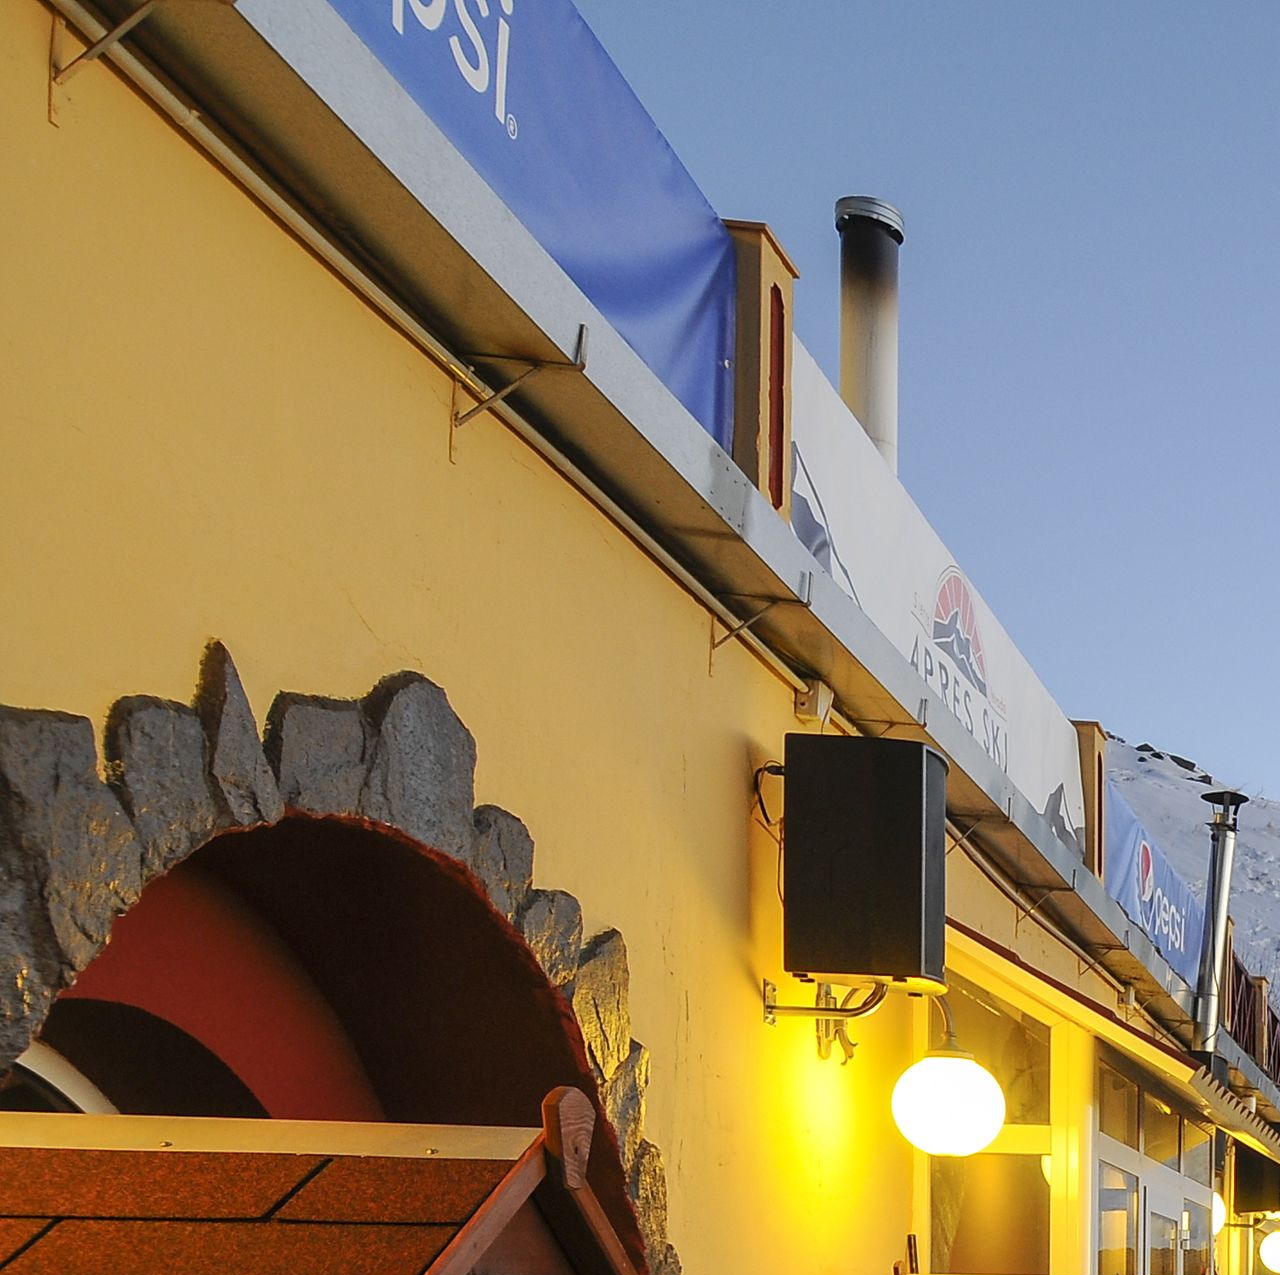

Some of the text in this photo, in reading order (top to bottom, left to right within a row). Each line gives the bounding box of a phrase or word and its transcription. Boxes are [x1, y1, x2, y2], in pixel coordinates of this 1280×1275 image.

[910, 634, 974, 736] APRES
[983, 708, 1008, 774] SKI
[1154, 887, 1186, 953] pepsi
